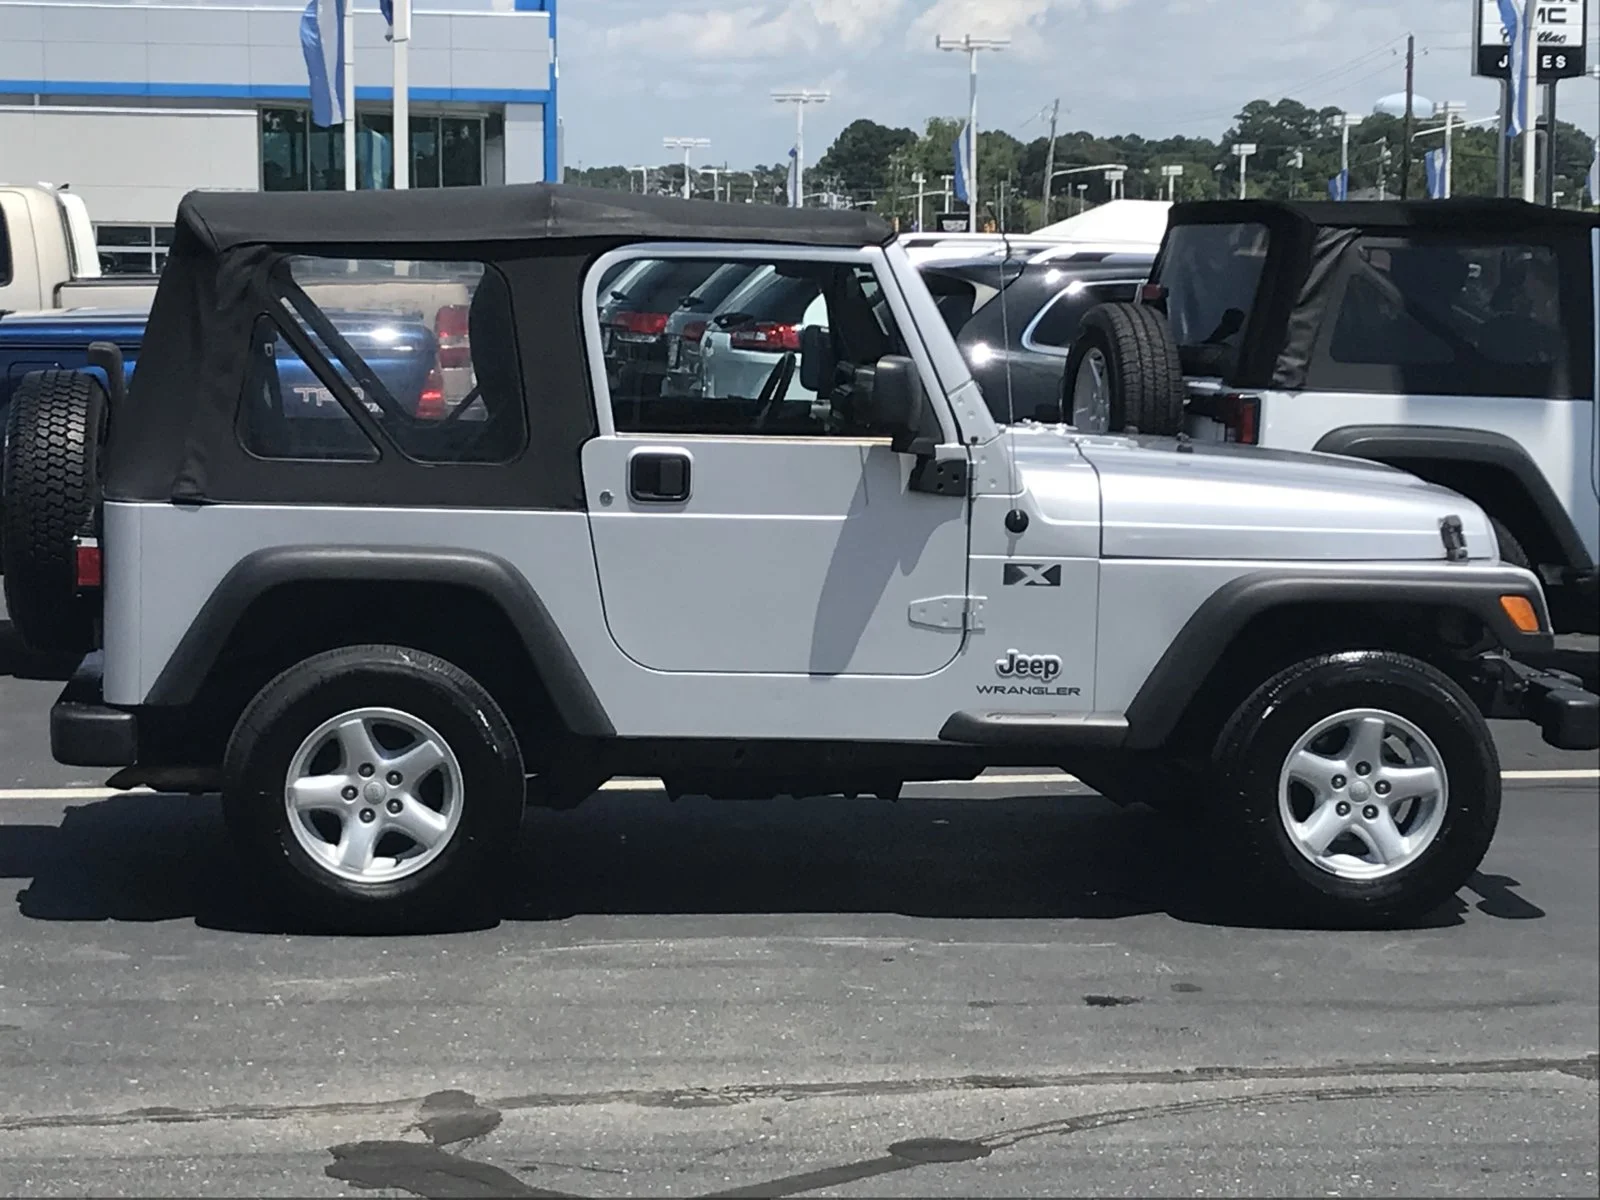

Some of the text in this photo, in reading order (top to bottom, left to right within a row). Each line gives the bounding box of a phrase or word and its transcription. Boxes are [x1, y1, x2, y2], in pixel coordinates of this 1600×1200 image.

[1498, 55, 1567, 69] JES
[1008, 563, 1059, 586] X
[996, 649, 1061, 681] Jeep
[976, 685, 1081, 696] WRANGLER
